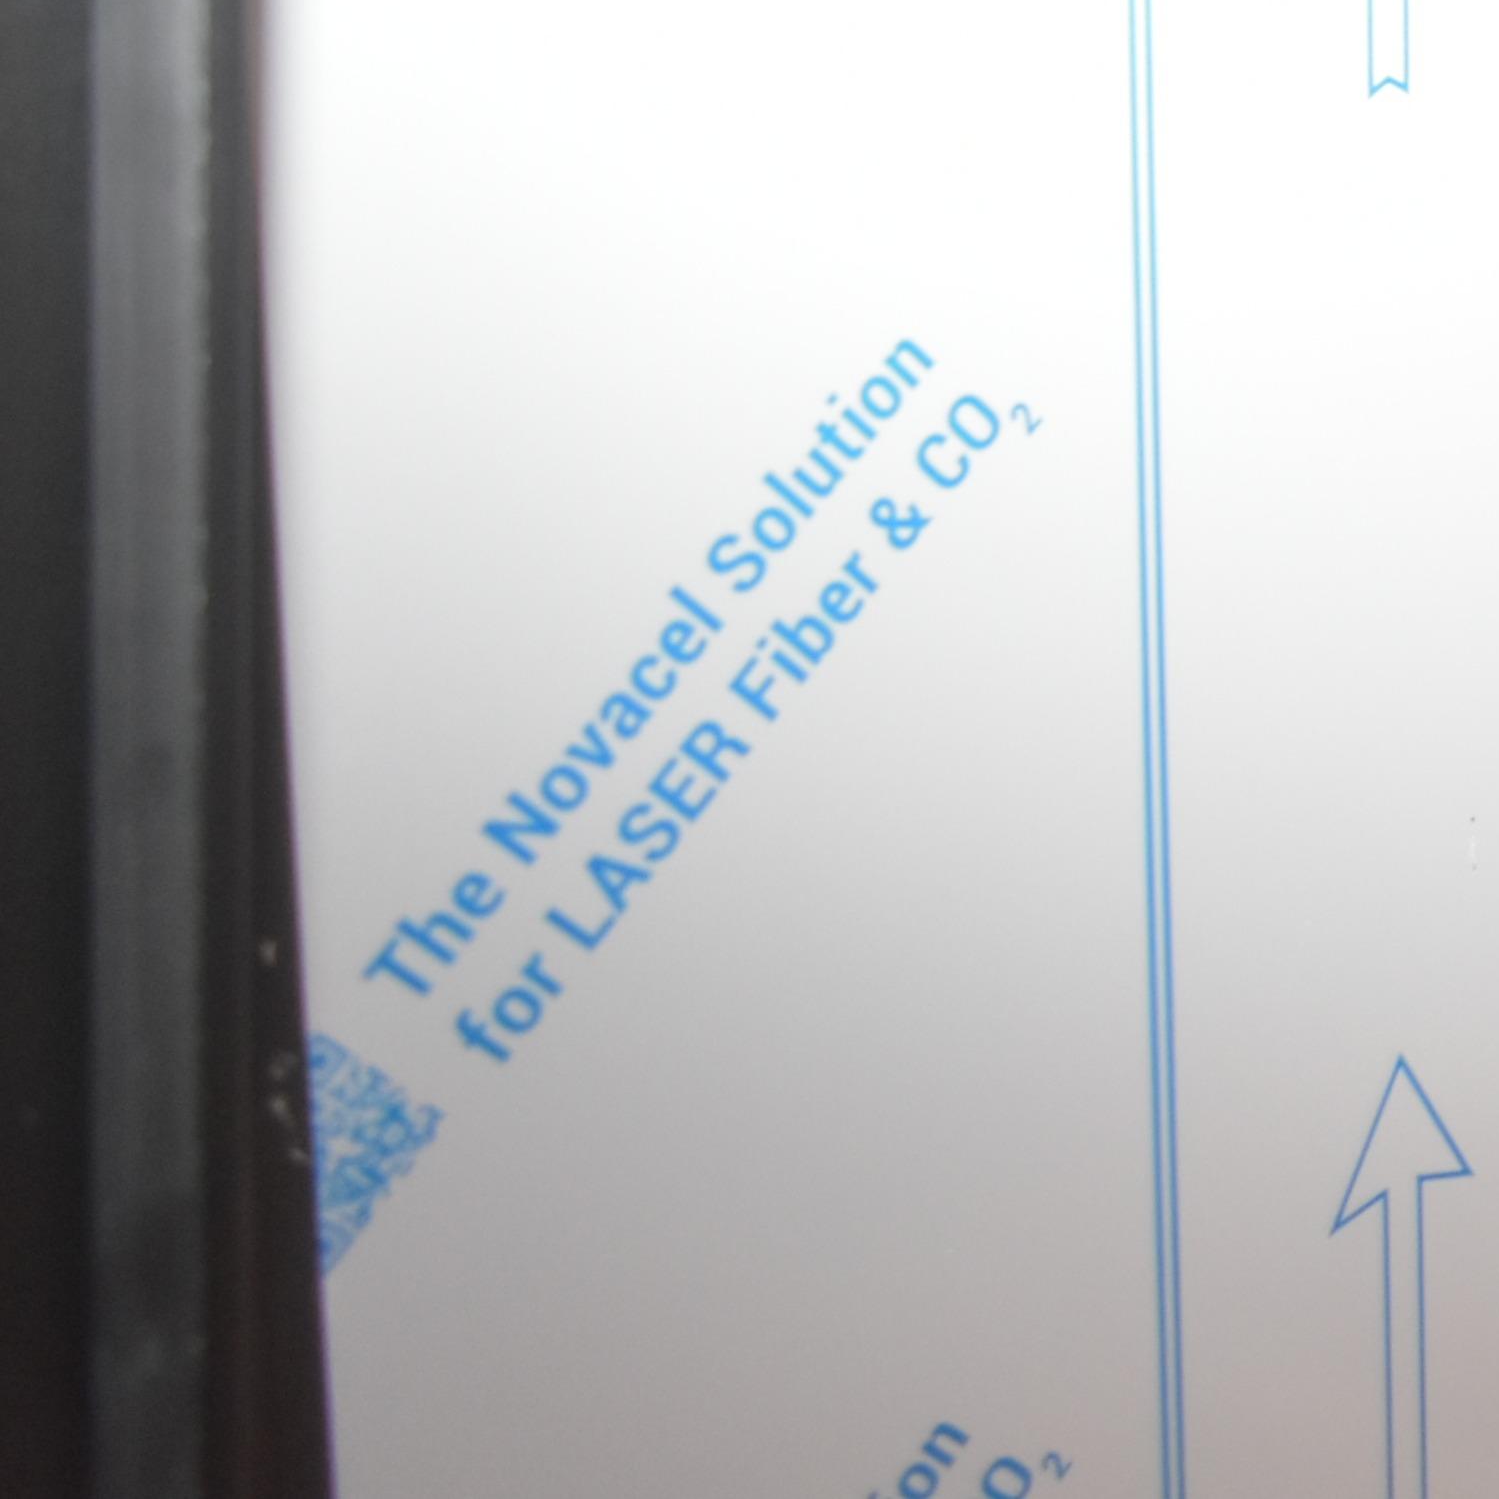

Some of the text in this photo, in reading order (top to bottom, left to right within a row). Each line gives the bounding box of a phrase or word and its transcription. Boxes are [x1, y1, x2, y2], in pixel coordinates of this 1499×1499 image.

[361, 336, 936, 1000] The Novacel Solution
[451, 949, 567, 1064] for
[543, 716, 752, 953] LASER
[726, 552, 880, 722] Fiber
[867, 495, 935, 550] &
